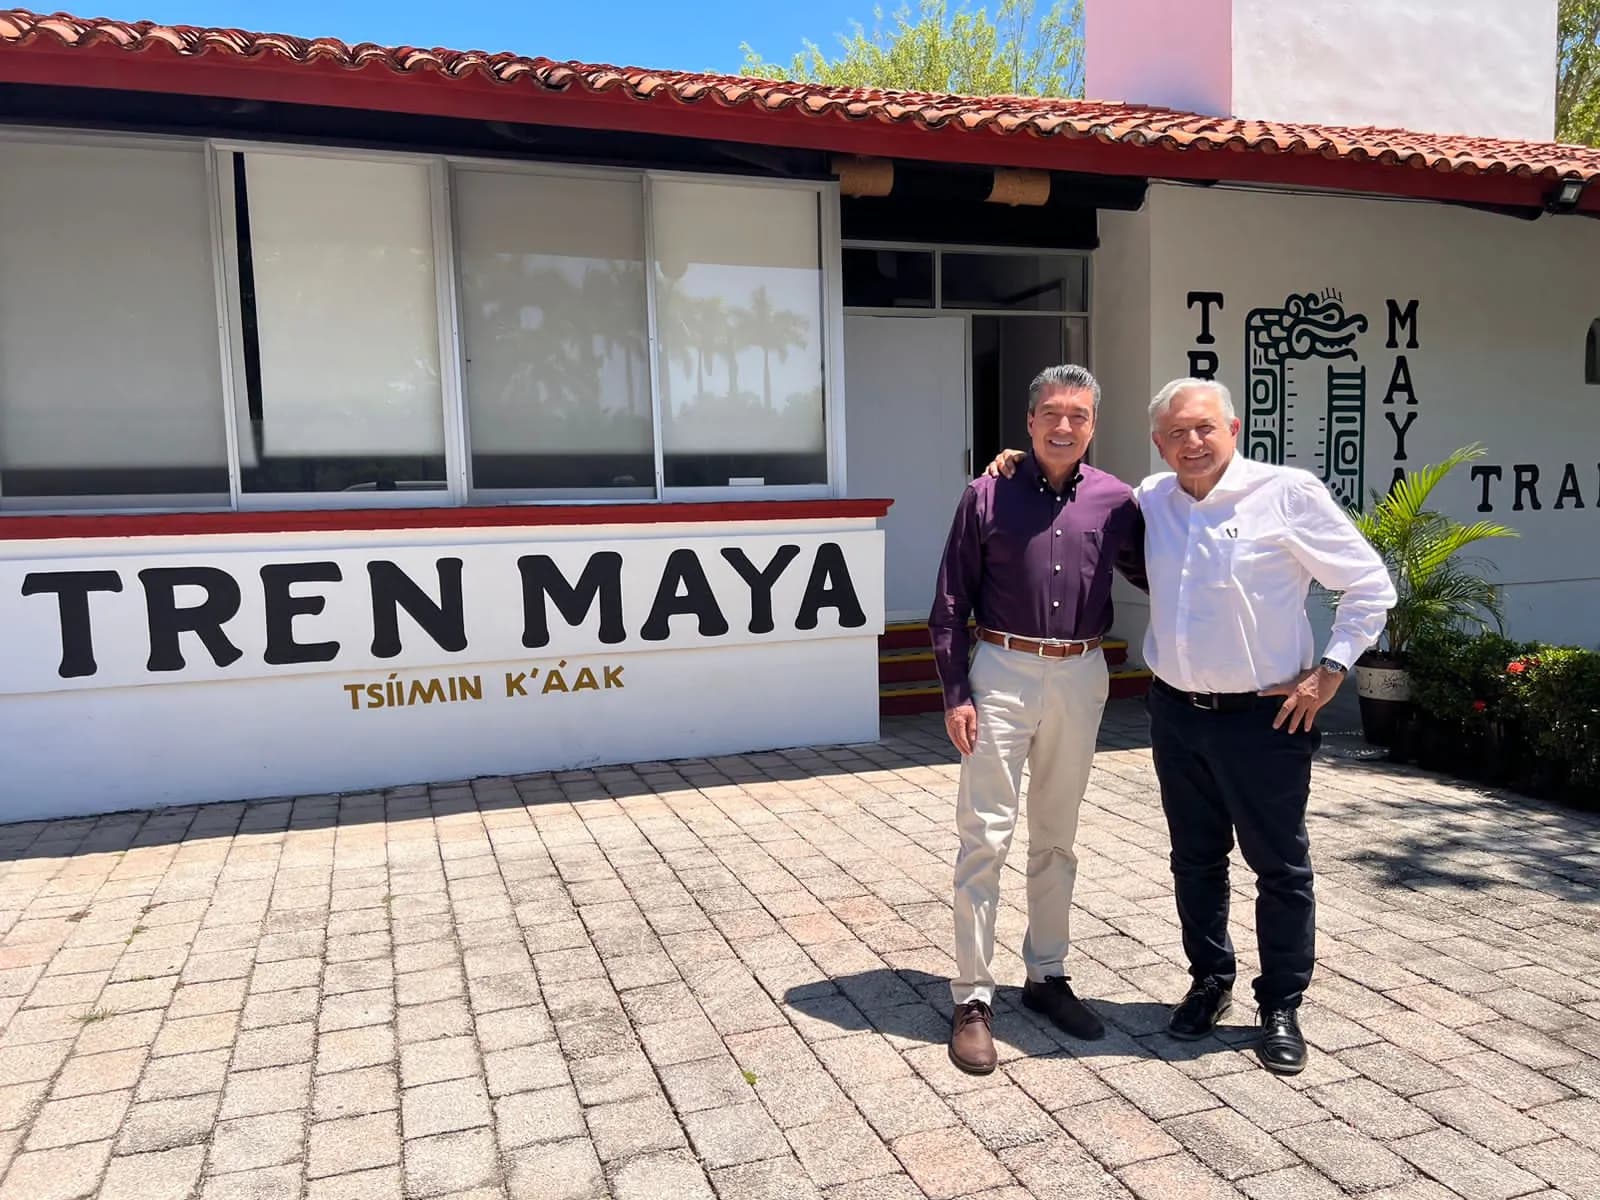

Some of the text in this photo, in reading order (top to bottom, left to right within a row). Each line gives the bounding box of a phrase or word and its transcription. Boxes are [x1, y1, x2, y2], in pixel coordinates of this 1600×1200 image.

[1186, 291, 1224, 381] TR
[1470, 463, 1600, 512] TRA
[22, 543, 866, 679] TREN MAYA
[343, 672, 483, 710] TSÍIMIN
